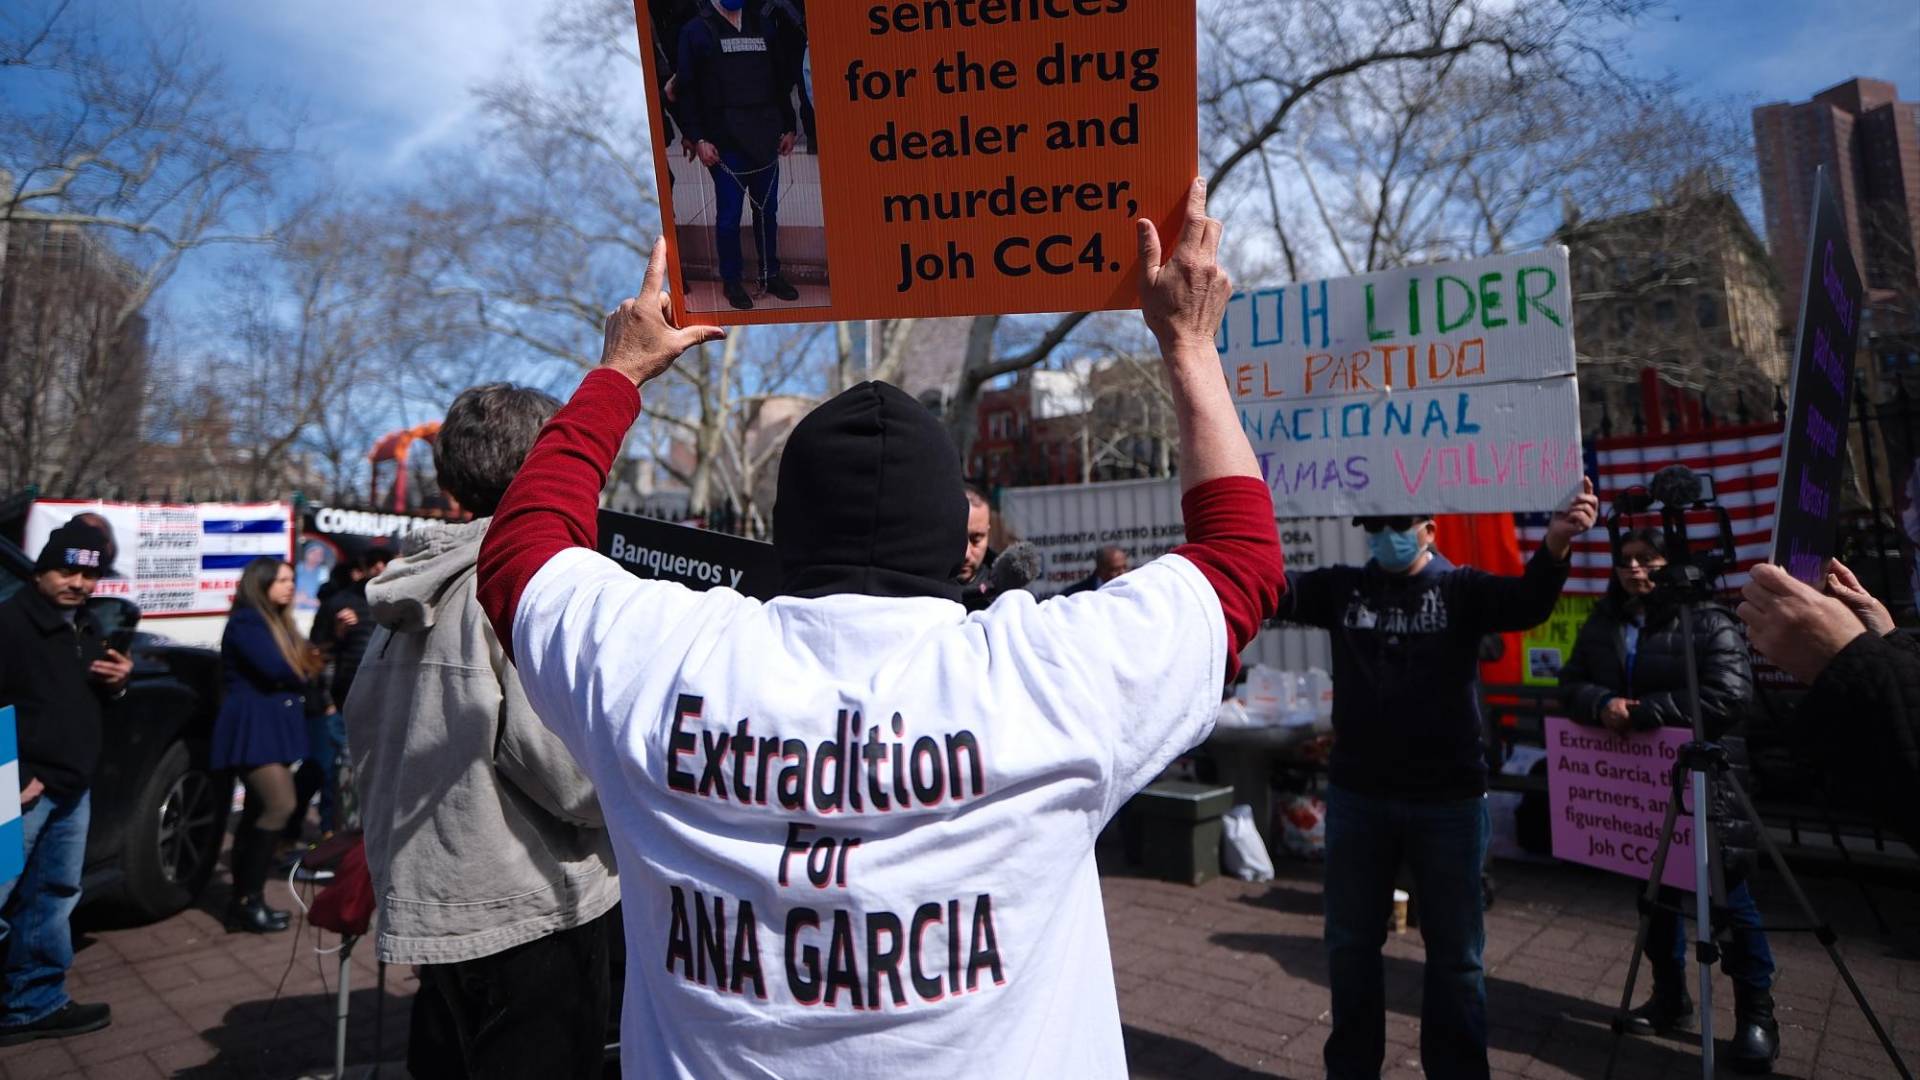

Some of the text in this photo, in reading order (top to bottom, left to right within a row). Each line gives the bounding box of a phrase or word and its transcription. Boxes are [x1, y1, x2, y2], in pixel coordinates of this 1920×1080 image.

[844, 42, 1160, 102] for the drug
[869, 102, 1140, 162] dealer and
[883, 175, 1138, 224] murderer,
[897, 232, 1121, 292] Joh CC4.
[1365, 267, 1564, 342] LIDER
[1224, 337, 1486, 397] EL PARTIDO
[1241, 393, 1481, 442] NACIONAL
[610, 533, 743, 590] Banqueros y
[667, 693, 985, 813] Extradition
[1558, 755, 1590, 776] Ana
[1595, 759, 1657, 788] Garcia,
[1559, 731, 1653, 757] Extradition
[1565, 805, 1691, 846] figureheads of
[1568, 785, 1669, 813] partners, an
[778, 821, 861, 888] For
[1588, 834, 1615, 856] Joh
[666, 885, 1007, 1010] ANA GARCIA
